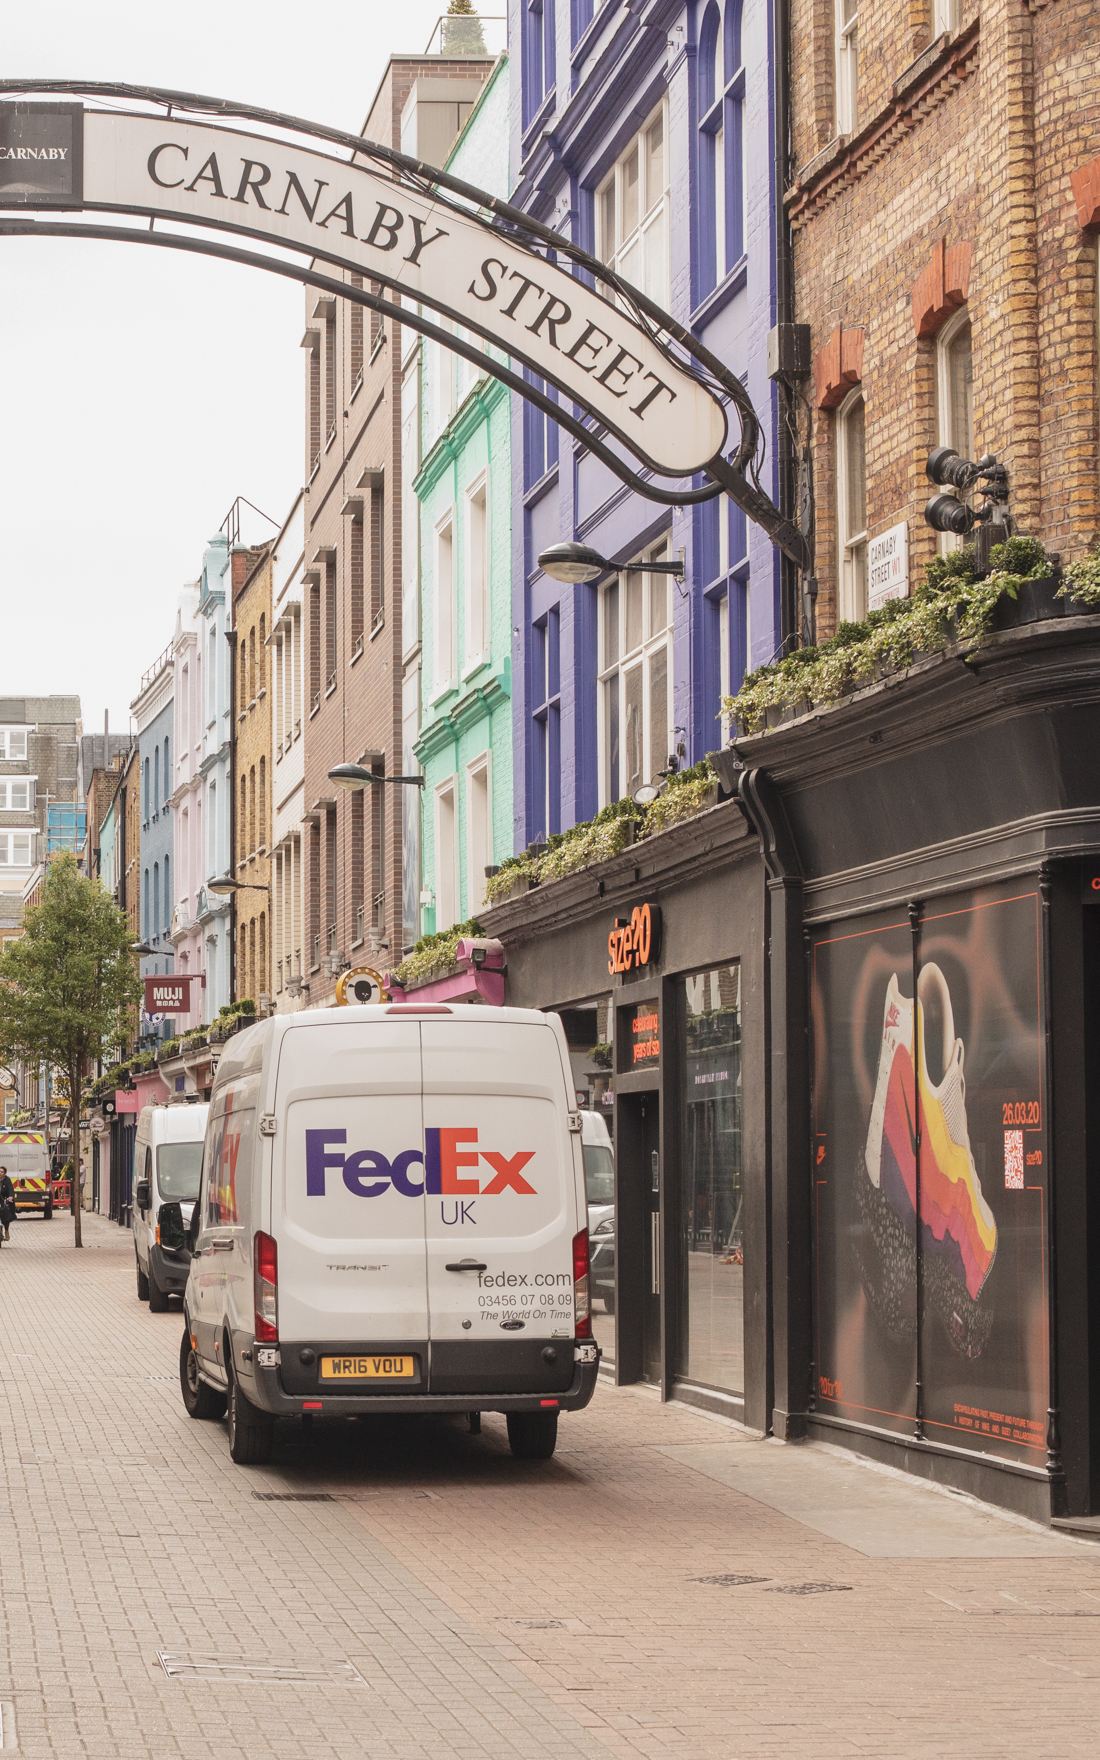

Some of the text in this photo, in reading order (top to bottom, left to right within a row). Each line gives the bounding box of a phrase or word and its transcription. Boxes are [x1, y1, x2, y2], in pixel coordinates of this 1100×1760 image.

[147, 142, 450, 268] CARNABY
[467, 258, 677, 421] STREET
[870, 534, 897, 565] CARNABY
[870, 556, 900, 588] STREET W1
[153, 987, 183, 1000] MUJI
[632, 1010, 658, 1034] celebrating
[633, 1042, 646, 1064] years
[646, 1036, 652, 1056] of
[1002, 1101, 1040, 1125] 26.03.20
[305, 1127, 538, 1198] FedEx
[441, 1200, 477, 1225] UK
[477, 1271, 571, 1288] fedex.com
[478, 1293, 572, 1307] 03456 07 08 09
[480, 1309, 571, 1320] The World On Time
[332, 1358, 403, 1374] WR16 VOU
[954, 1415, 957, 1424] A
[958, 1416, 973, 1427] HISTORY
[975, 1419, 980, 1429] OF
